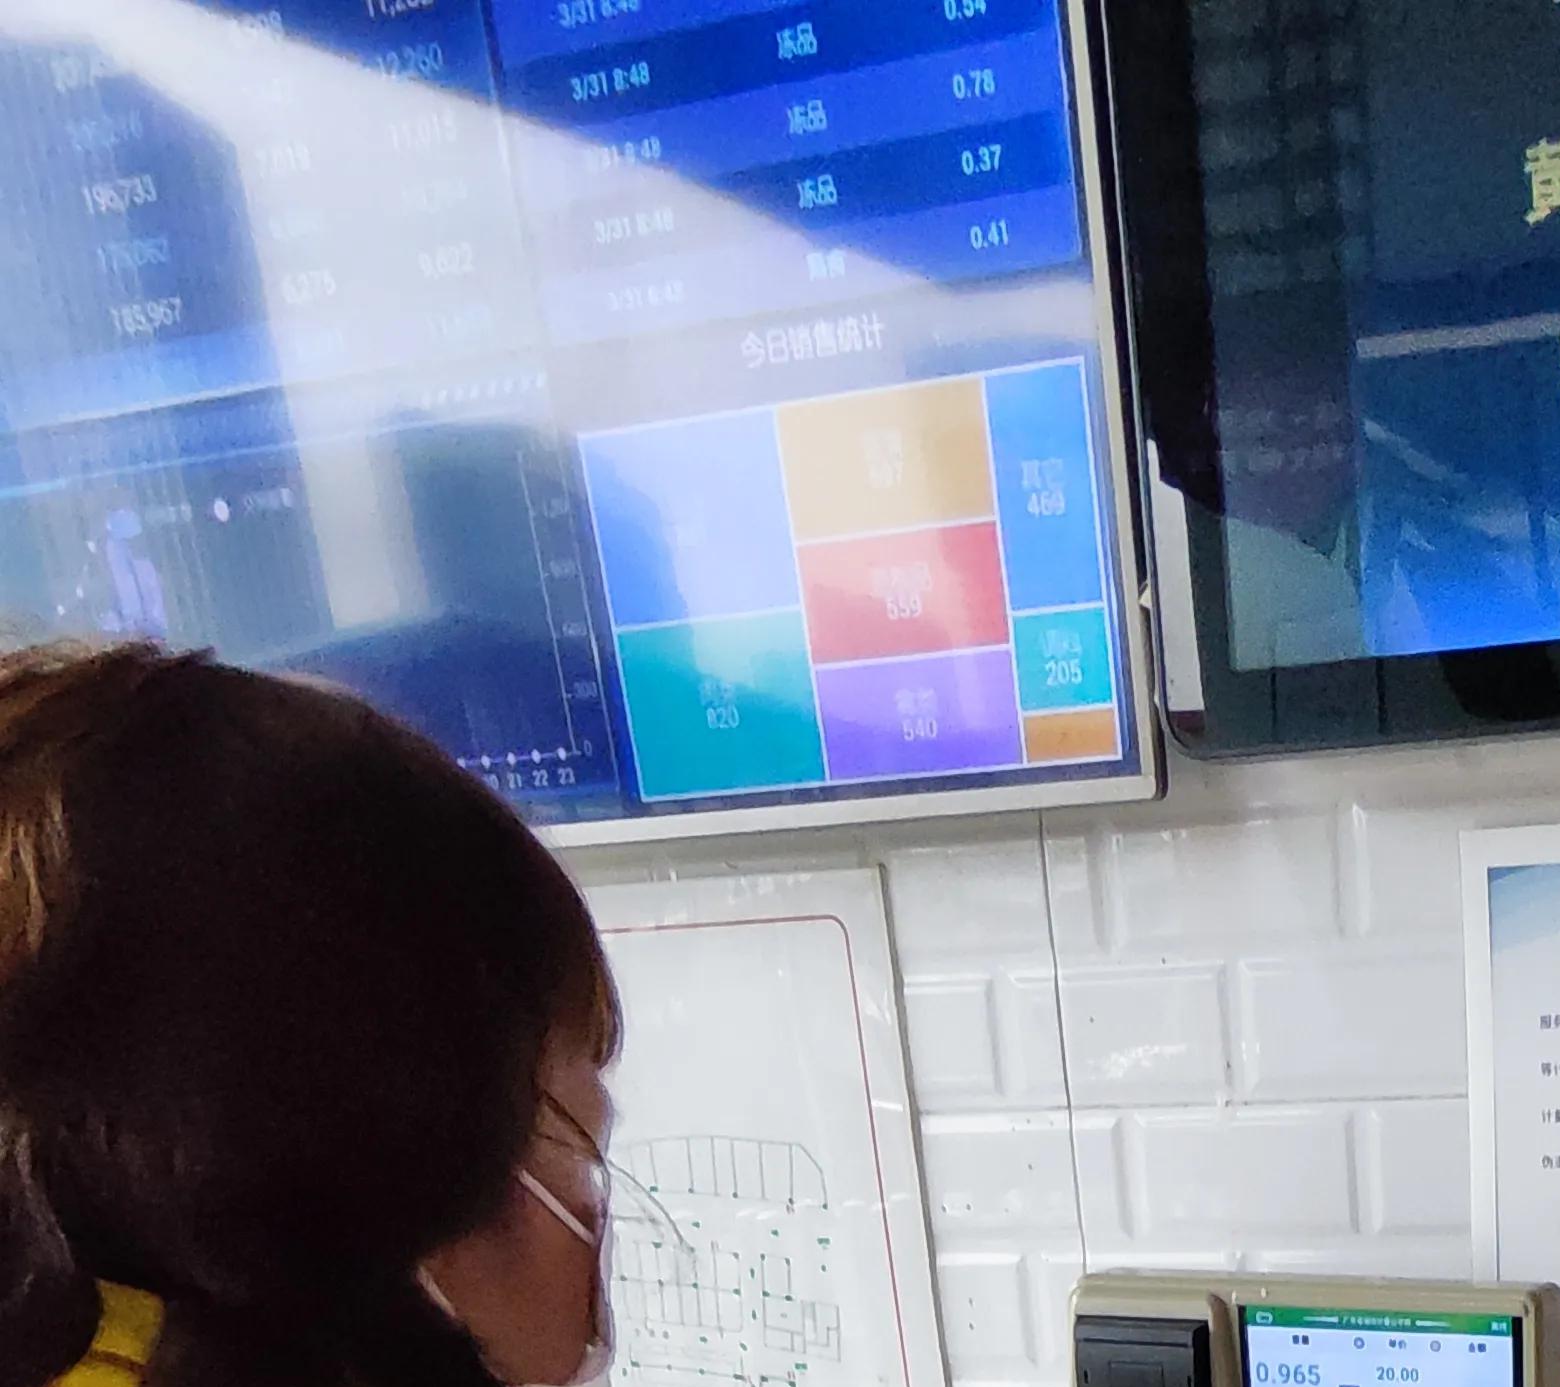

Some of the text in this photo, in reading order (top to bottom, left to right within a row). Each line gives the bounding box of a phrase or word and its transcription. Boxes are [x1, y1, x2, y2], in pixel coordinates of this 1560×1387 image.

[571, 71, 608, 101] 3/31
[953, 68, 995, 100] 0.78
[962, 144, 1002, 175] 0.37
[970, 220, 1009, 251] 0.41
[1046, 660, 1084, 686] 205
[1256, 1362, 1322, 1386] 0.965
[1376, 1366, 1420, 1382] 20.00
